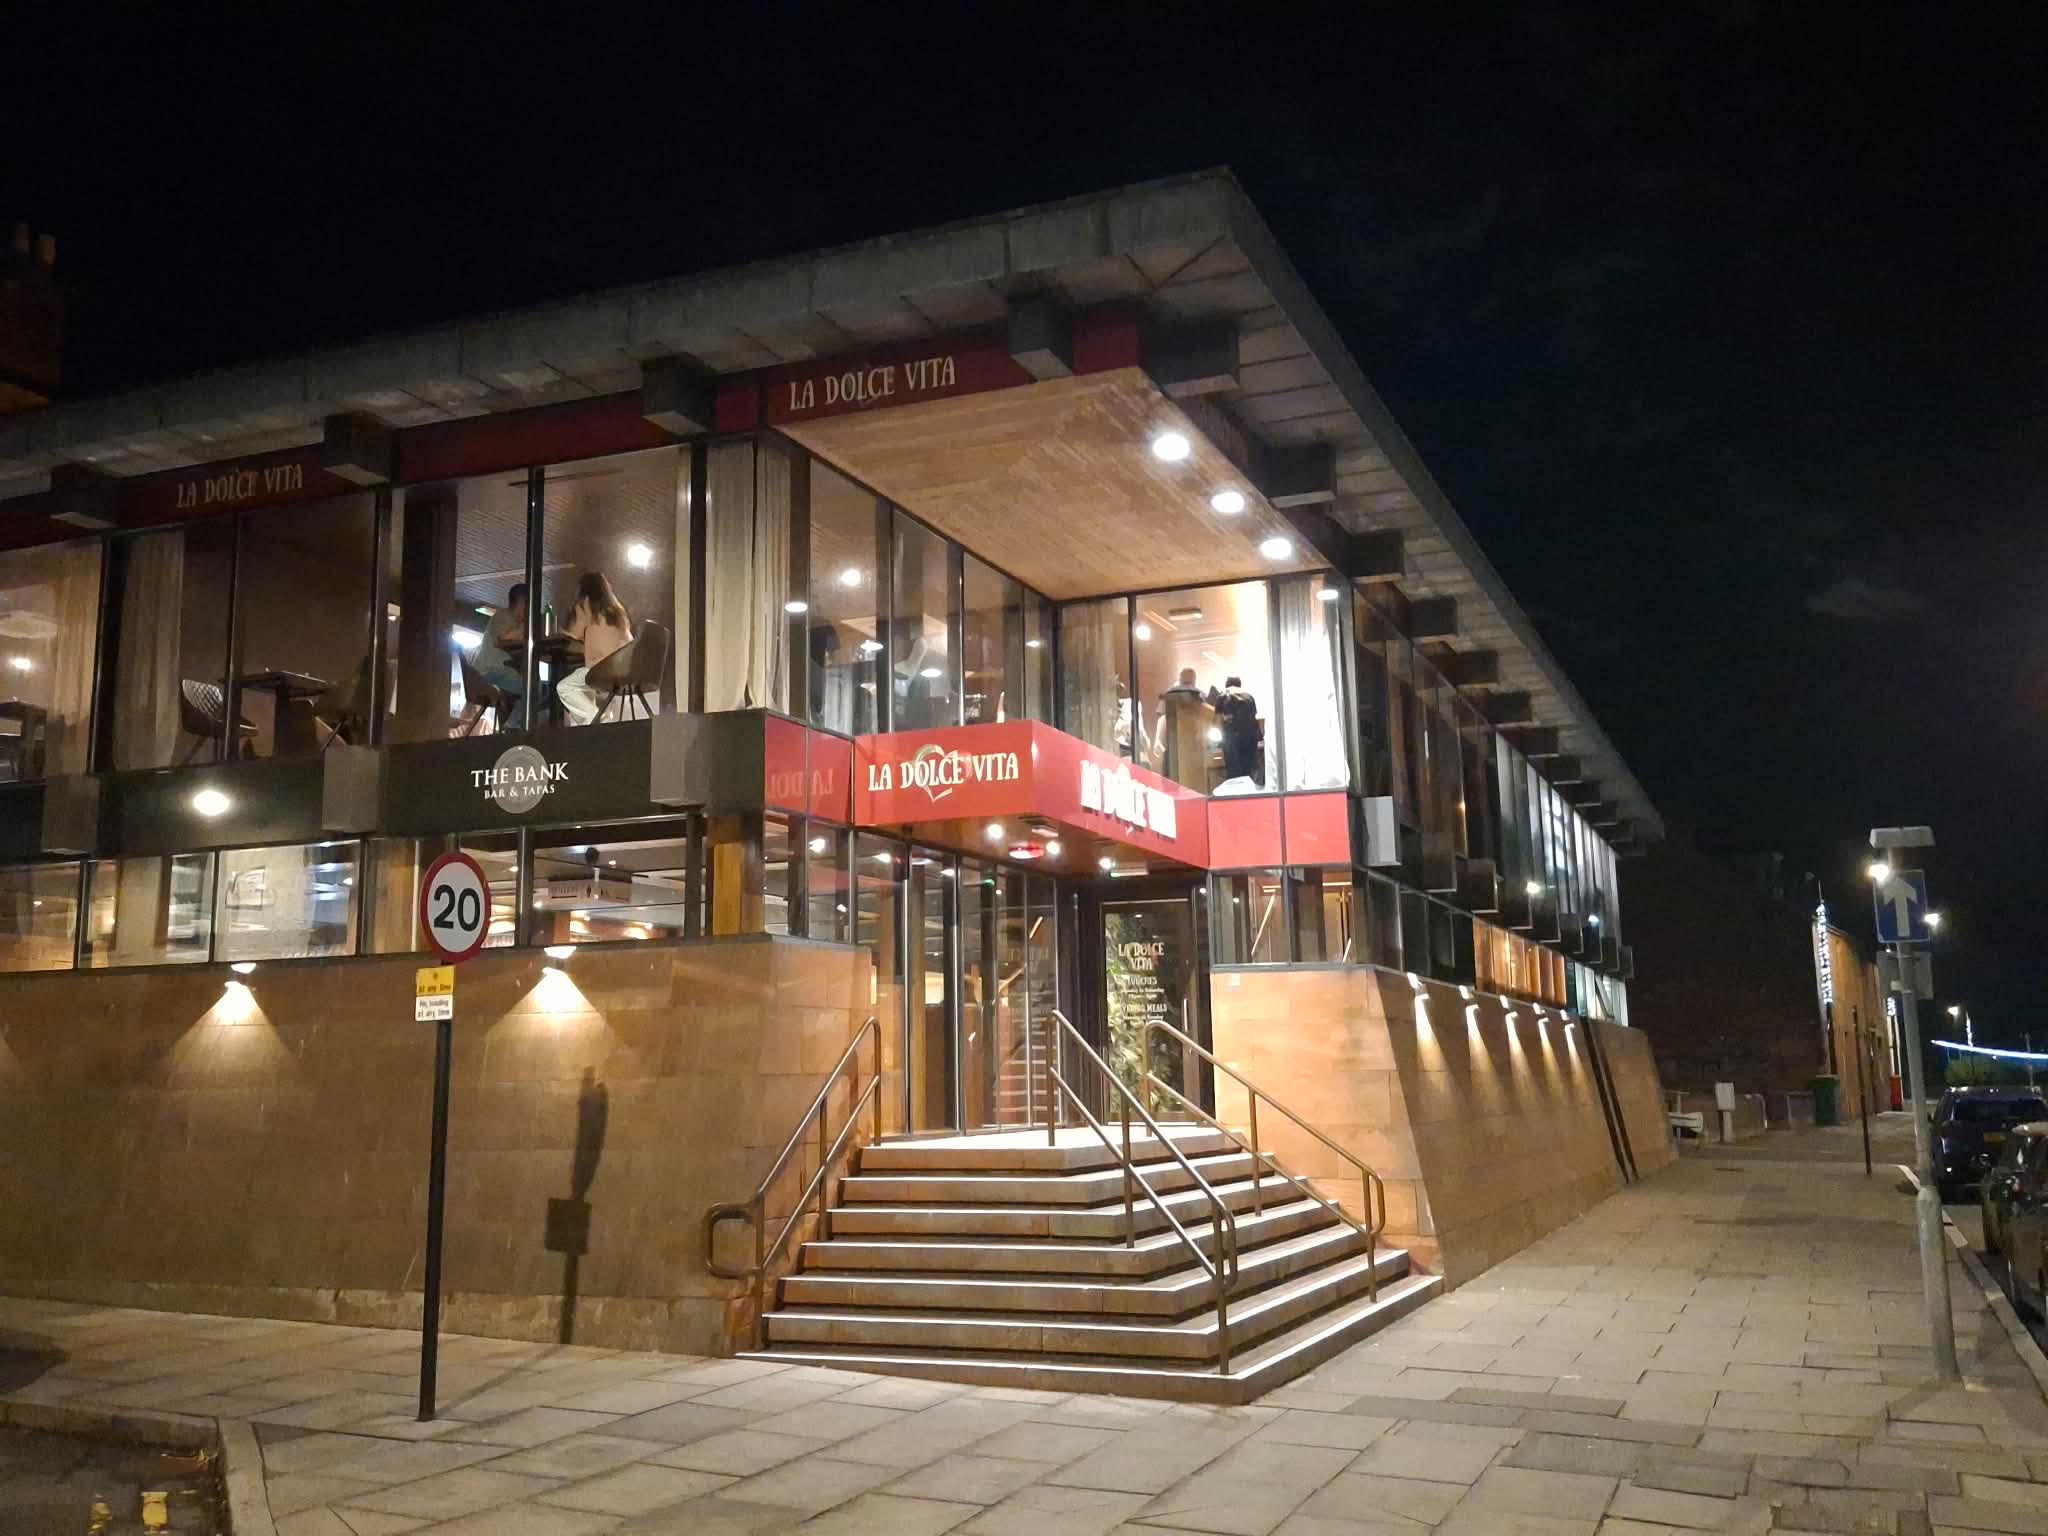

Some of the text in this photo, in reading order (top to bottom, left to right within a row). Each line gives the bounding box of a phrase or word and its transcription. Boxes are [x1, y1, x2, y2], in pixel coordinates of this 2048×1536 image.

[788, 355, 956, 411] LA DOLCE VITA
[176, 463, 303, 508] LA DOLCE VITA
[470, 762, 569, 788] THE BANK
[868, 752, 1019, 791] LA DOLCE VITA
[484, 783, 555, 800] BAR & TAPAS
[433, 884, 481, 932] 20
[1118, 942, 1165, 957] LA DOLCE
[1129, 957, 1153, 971] VITA
